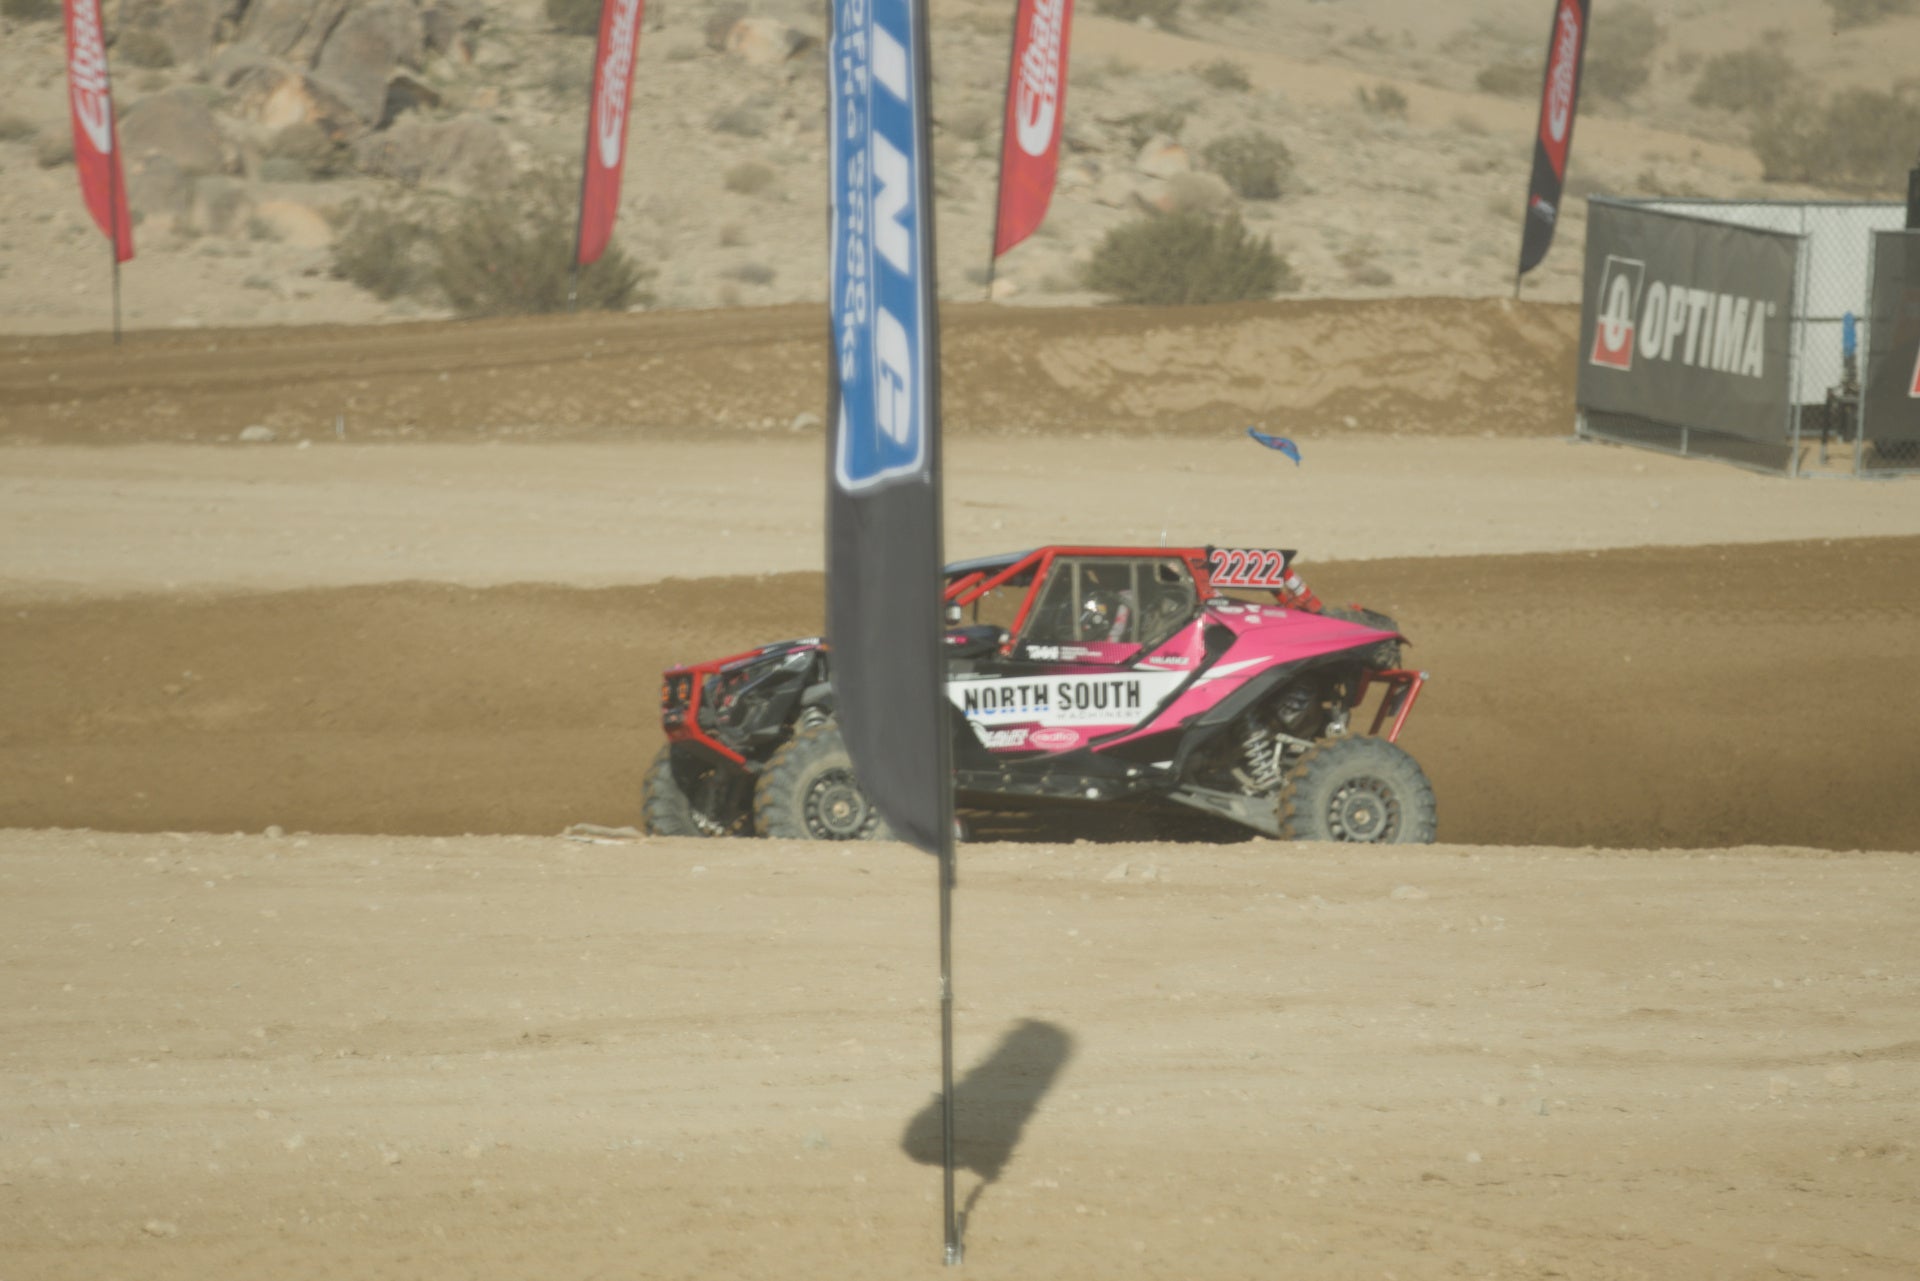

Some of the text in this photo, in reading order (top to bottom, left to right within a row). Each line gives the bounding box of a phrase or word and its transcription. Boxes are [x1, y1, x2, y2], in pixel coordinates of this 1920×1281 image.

[842, 0, 857, 139] CING
[872, 18, 911, 444] ING
[1639, 281, 1766, 378] OPTIMA
[1209, 549, 1284, 588] 2222
[964, 681, 1140, 715] NORTH SOUTH
